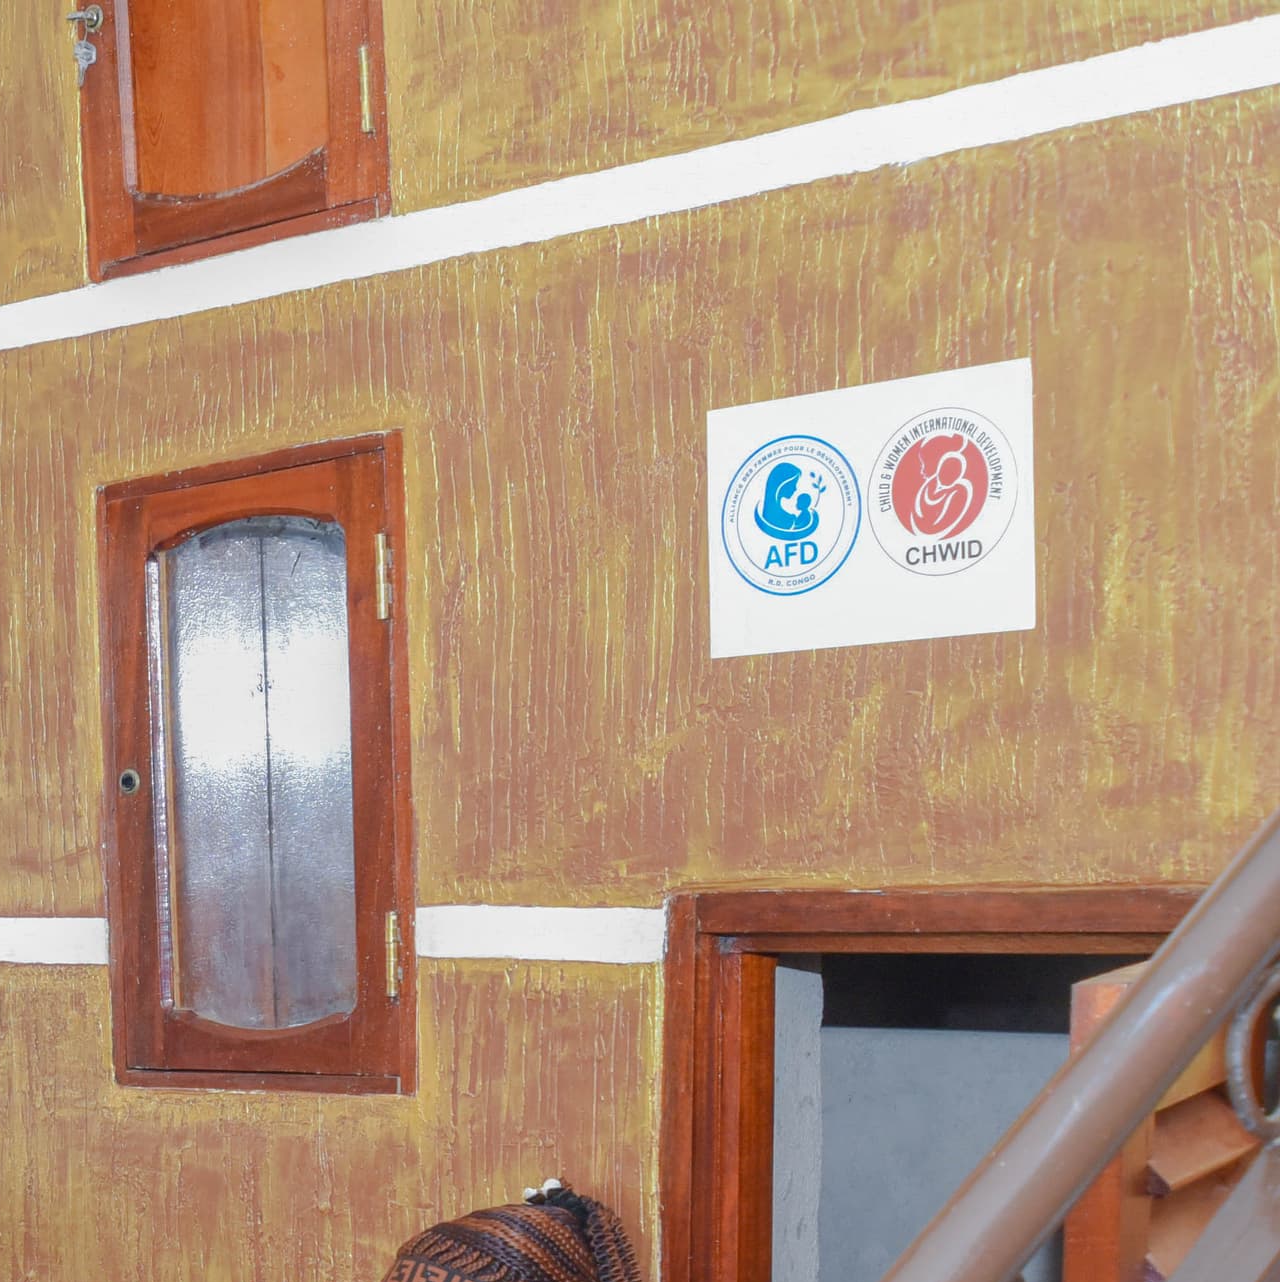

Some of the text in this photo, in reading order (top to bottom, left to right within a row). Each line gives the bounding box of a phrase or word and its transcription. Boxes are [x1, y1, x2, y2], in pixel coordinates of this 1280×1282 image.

[909, 416, 978, 441] INTERNATIONAL
[883, 437, 912, 471] WOMEN
[976, 431, 1004, 500] DEVELOPMENT
[879, 483, 892, 513] CHILD
[764, 541, 819, 569] AFD
[906, 539, 983, 566] CHWID
[786, 574, 816, 586] CONGO
